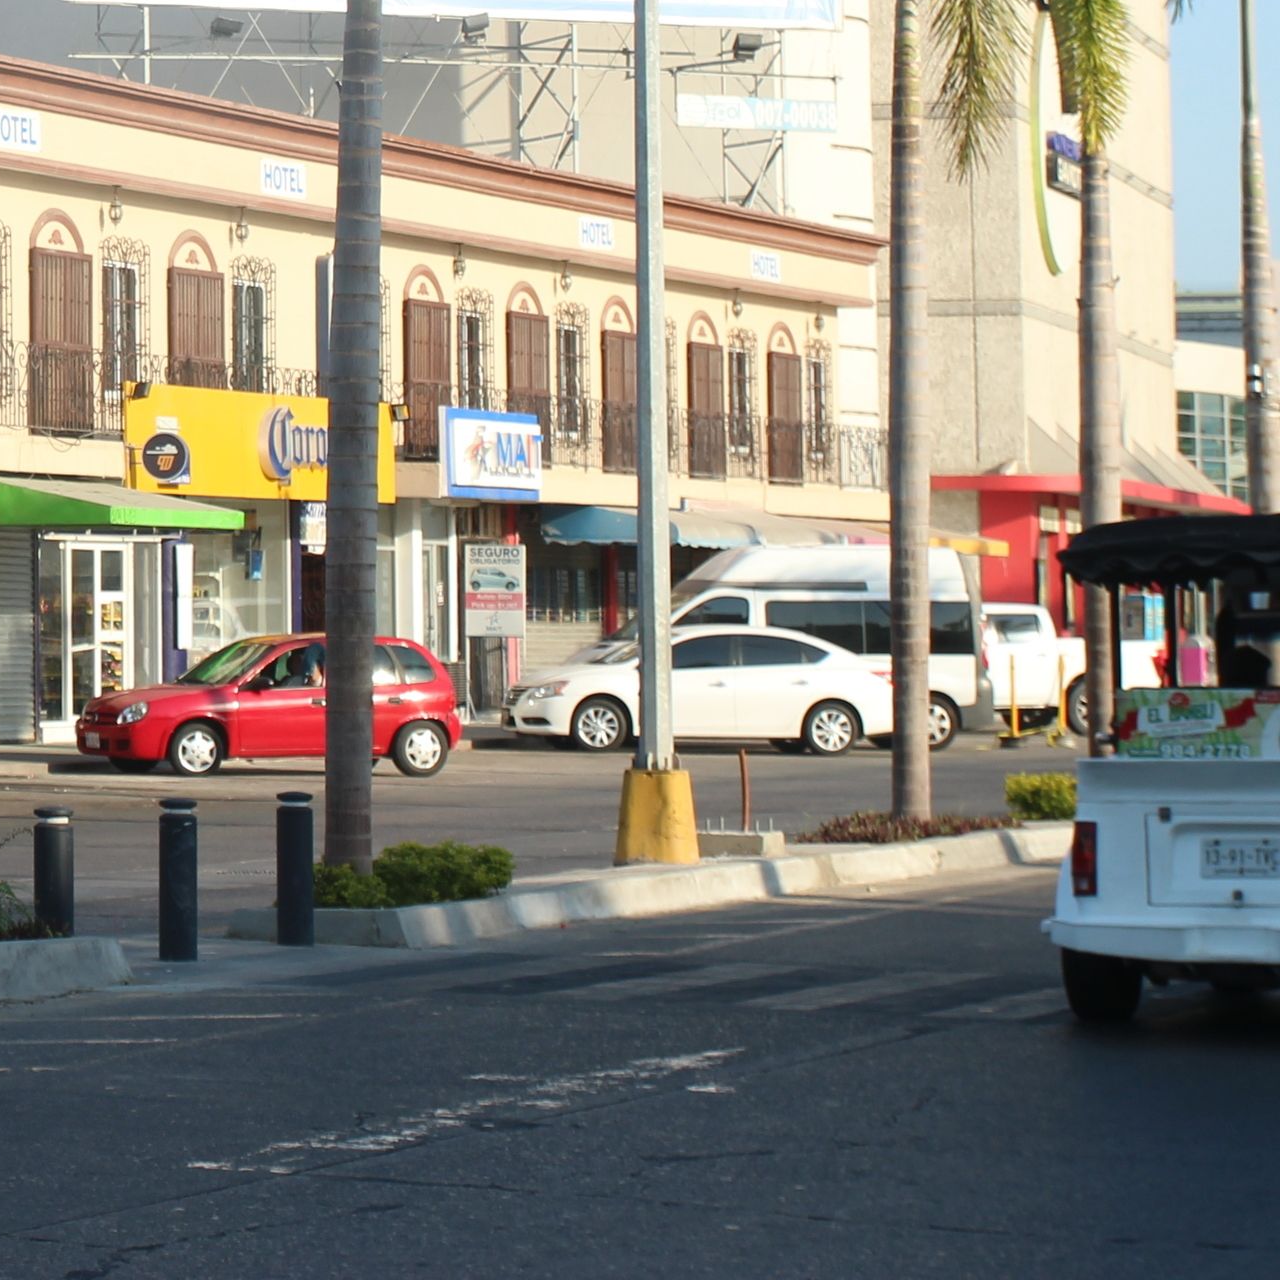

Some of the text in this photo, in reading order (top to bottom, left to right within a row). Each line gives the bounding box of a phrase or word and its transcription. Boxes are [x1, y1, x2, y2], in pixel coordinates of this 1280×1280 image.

[264, 163, 303, 193] HOTEL
[582, 222, 612, 246] HOTEL
[752, 253, 779, 278] HOTEL
[266, 405, 329, 480] Coro
[496, 432, 544, 470] MAIT
[469, 547, 520, 558] SEGURO
